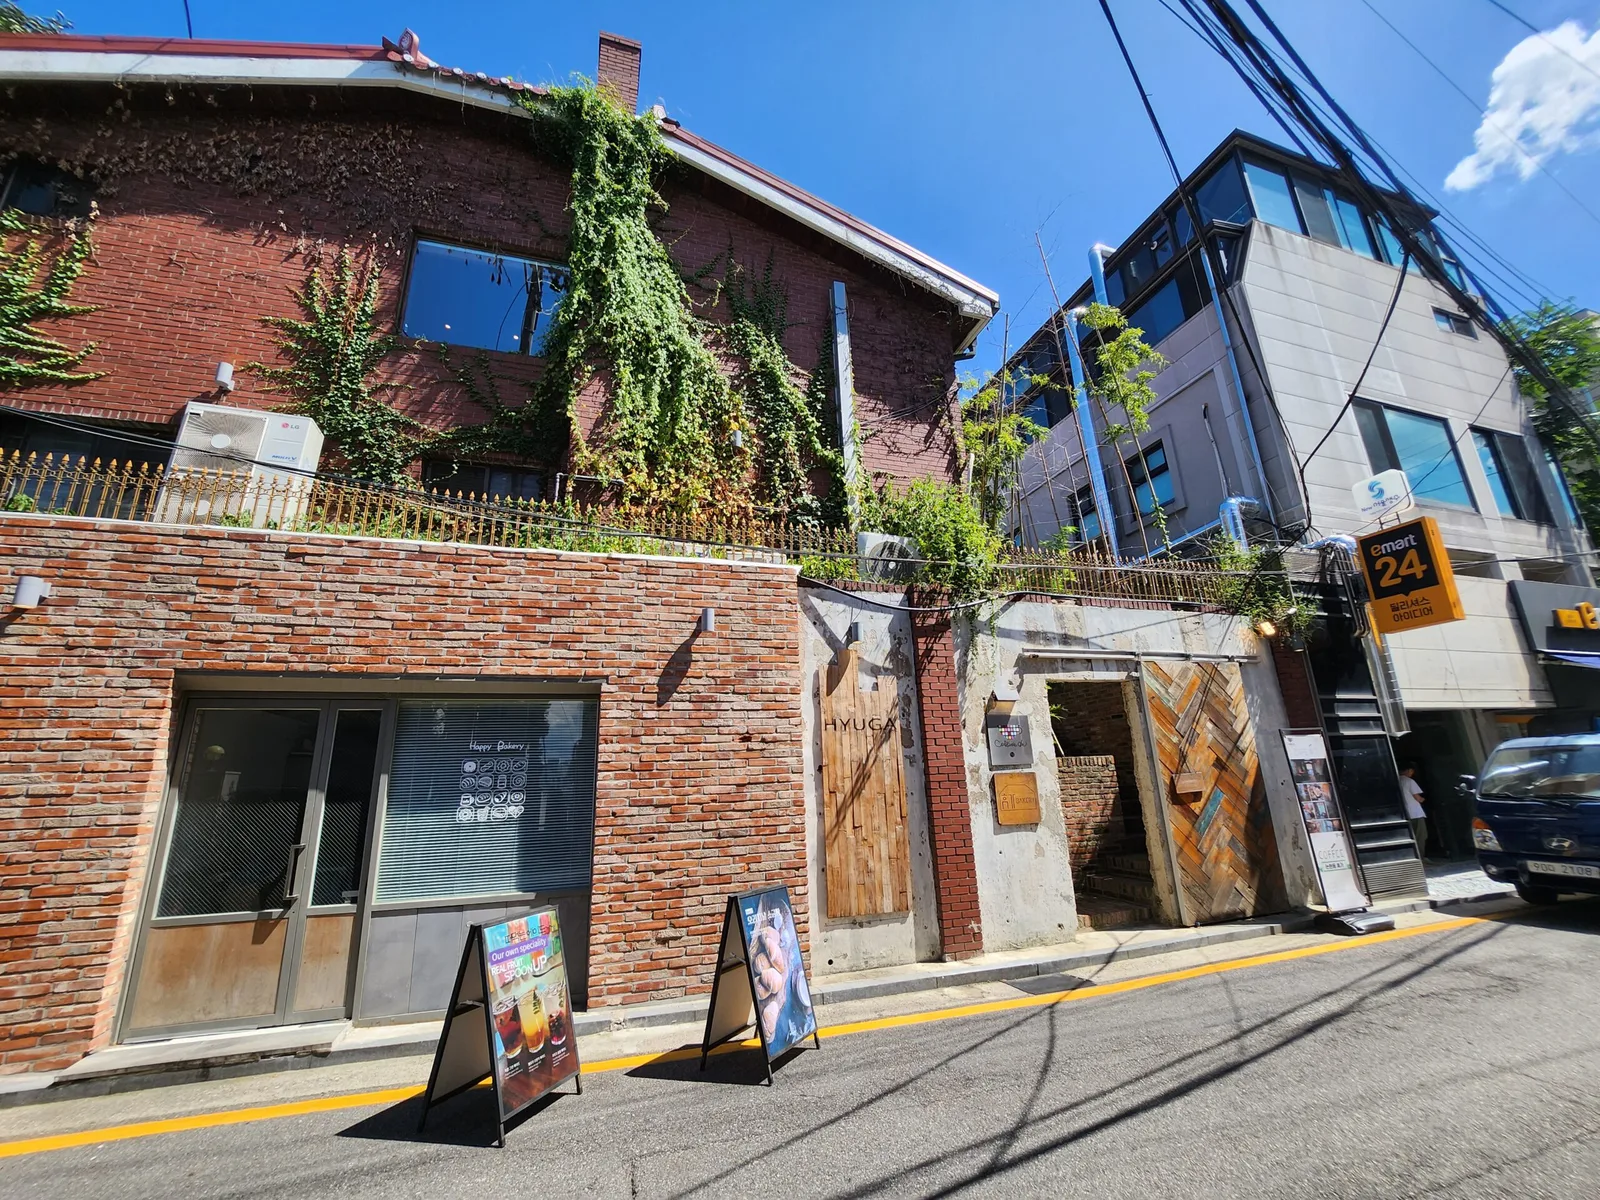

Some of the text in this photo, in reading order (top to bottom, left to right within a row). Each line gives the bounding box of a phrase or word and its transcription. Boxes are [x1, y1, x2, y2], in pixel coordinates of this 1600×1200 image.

[1370, 534, 1417, 557] emart
[1375, 549, 1427, 587] 24
[1390, 597, 1431, 612] 딜리셔스
[1393, 606, 1434, 622] 아이디어
[1576, 602, 1600, 629] e
[824, 718, 897, 731] HYUGA
[469, 740, 525, 752] Happy Bakery
[1318, 850, 1345, 860] COFFEE
[1561, 864, 1592, 876] 2108
[492, 938, 547, 961] Our own speciality
[491, 958, 523, 975] REAL FRUIT
